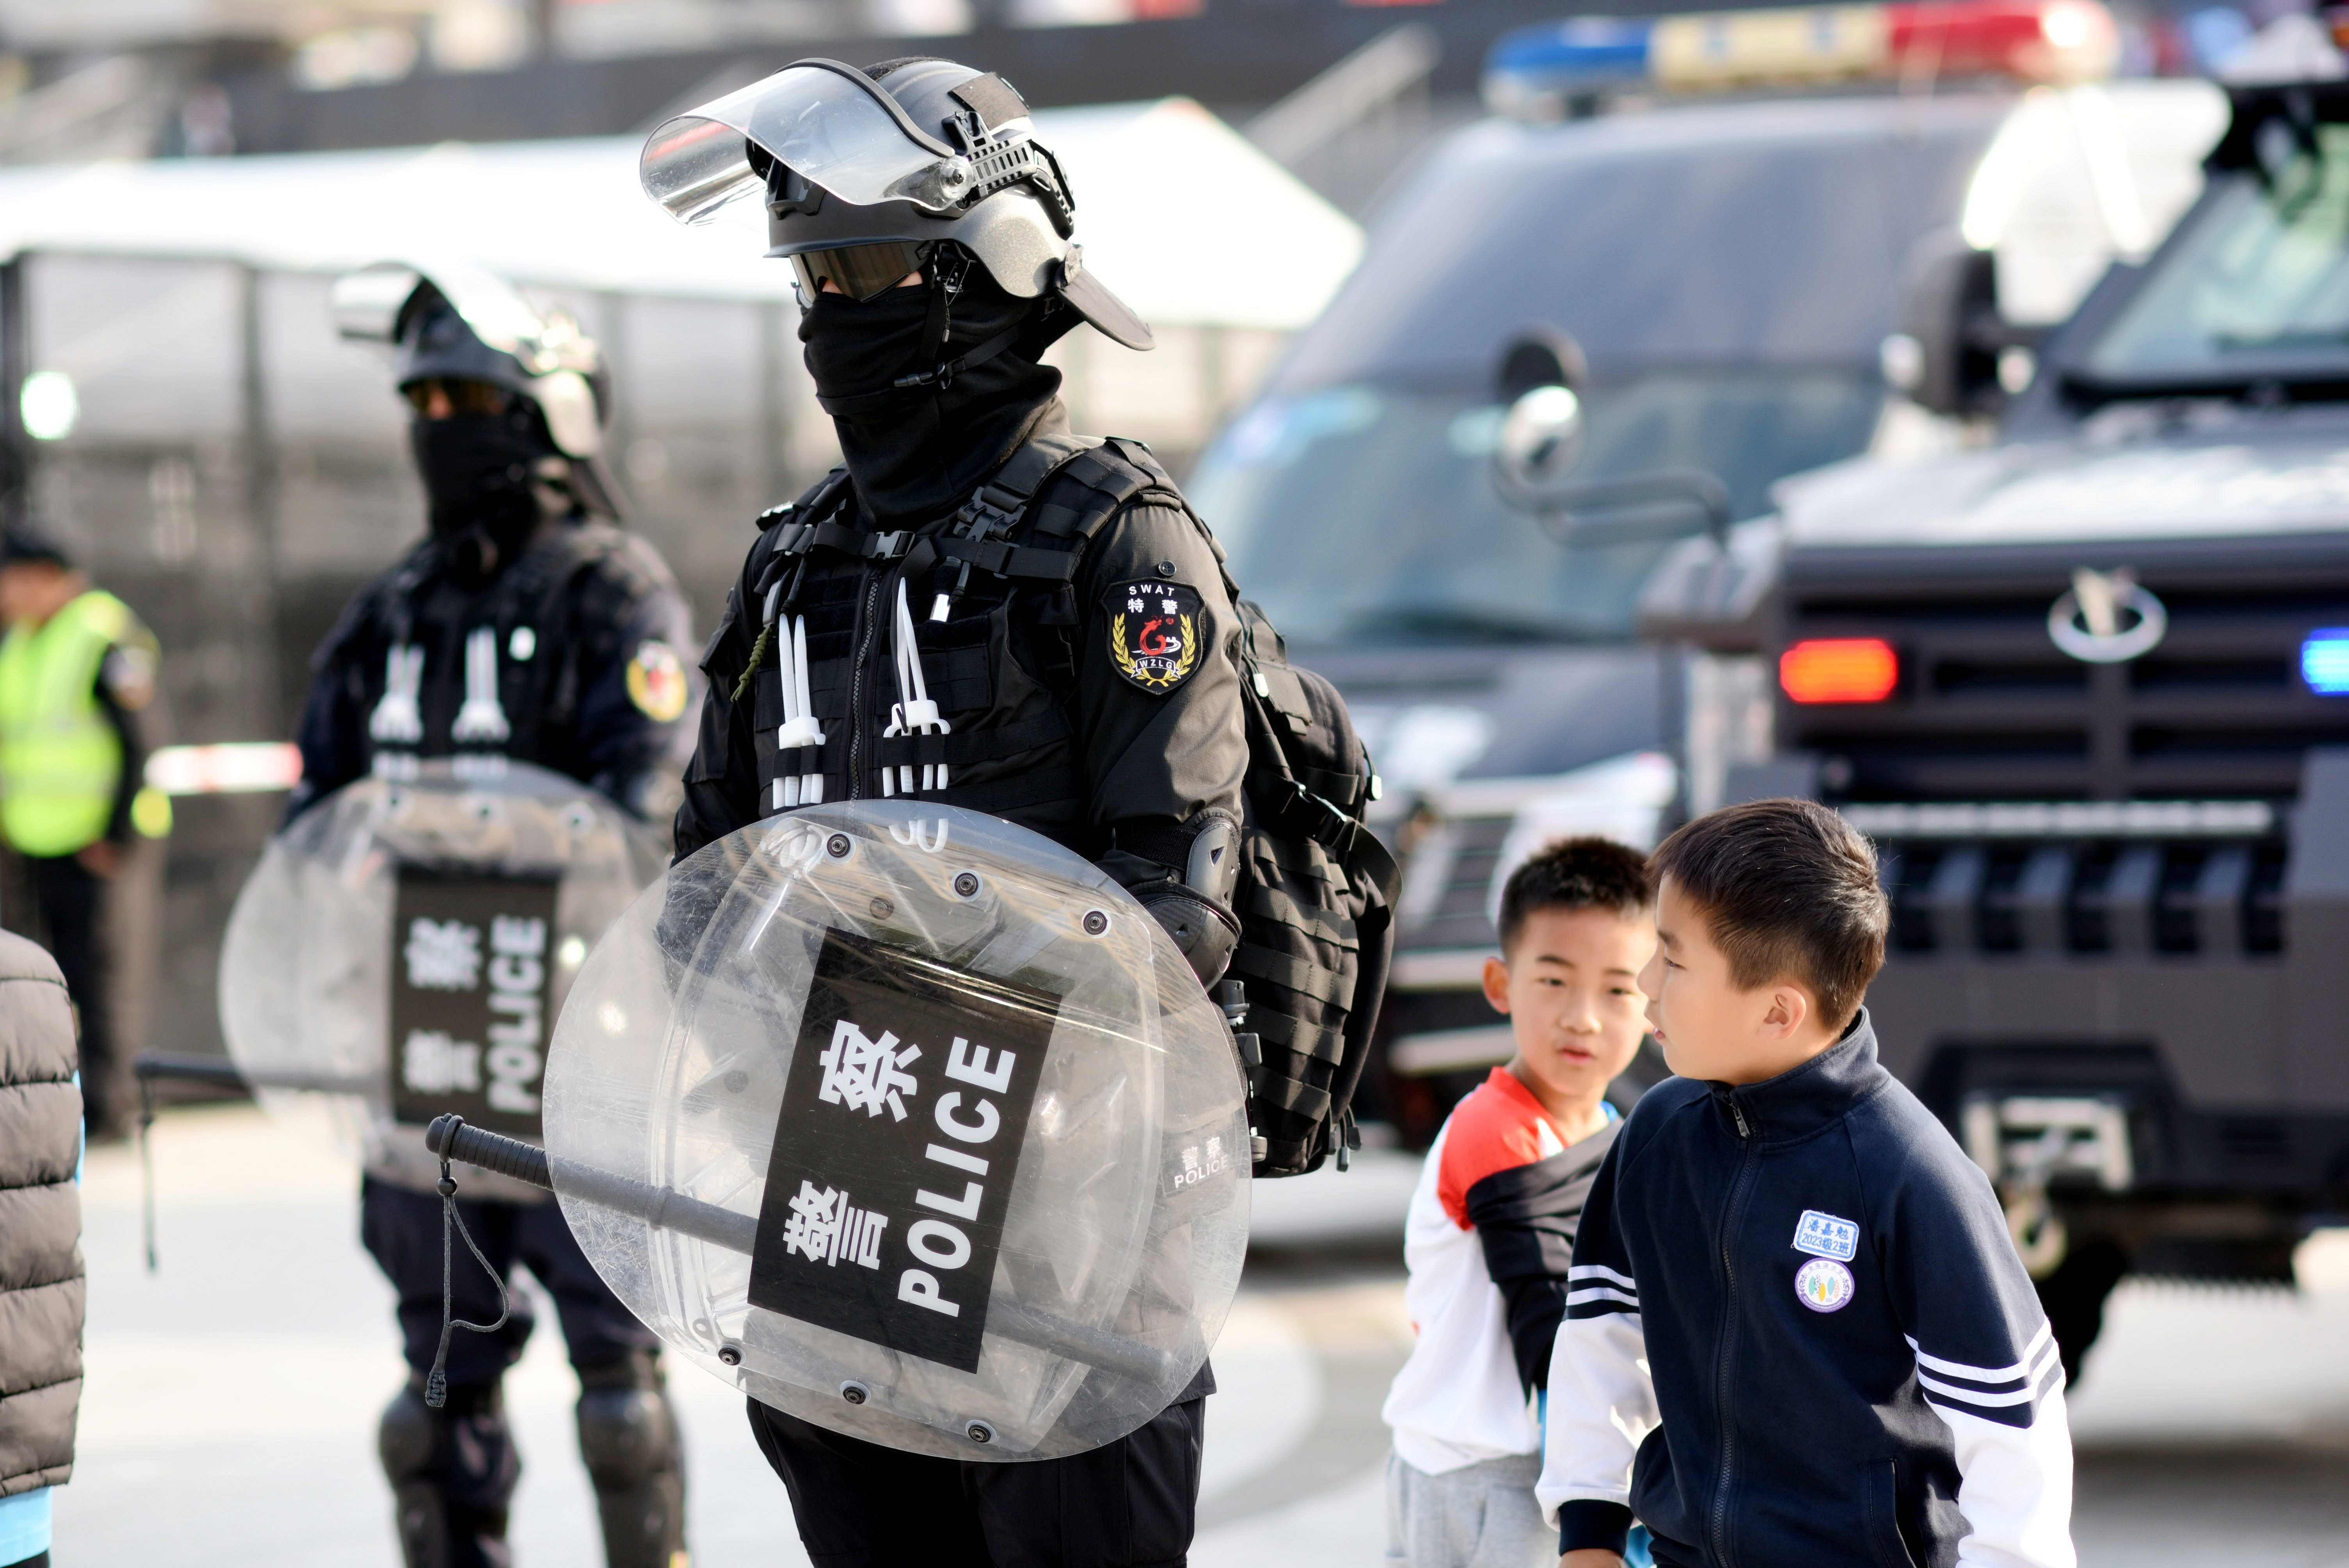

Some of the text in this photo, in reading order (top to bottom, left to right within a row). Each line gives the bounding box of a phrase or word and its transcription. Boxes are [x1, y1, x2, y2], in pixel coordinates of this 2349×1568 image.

[1127, 598, 1178, 615] 特警
[1128, 584, 1174, 597] SWAT
[1139, 659, 1173, 668] WZLG
[487, 914, 546, 1114] POLICE
[782, 1019, 923, 1270] 警察
[1182, 1137, 1221, 1171] 警察
[897, 1036, 1016, 1318] POLICE
[1174, 1155, 1228, 1188] POLICE
[1801, 1233, 1850, 1254] 2023级2班
